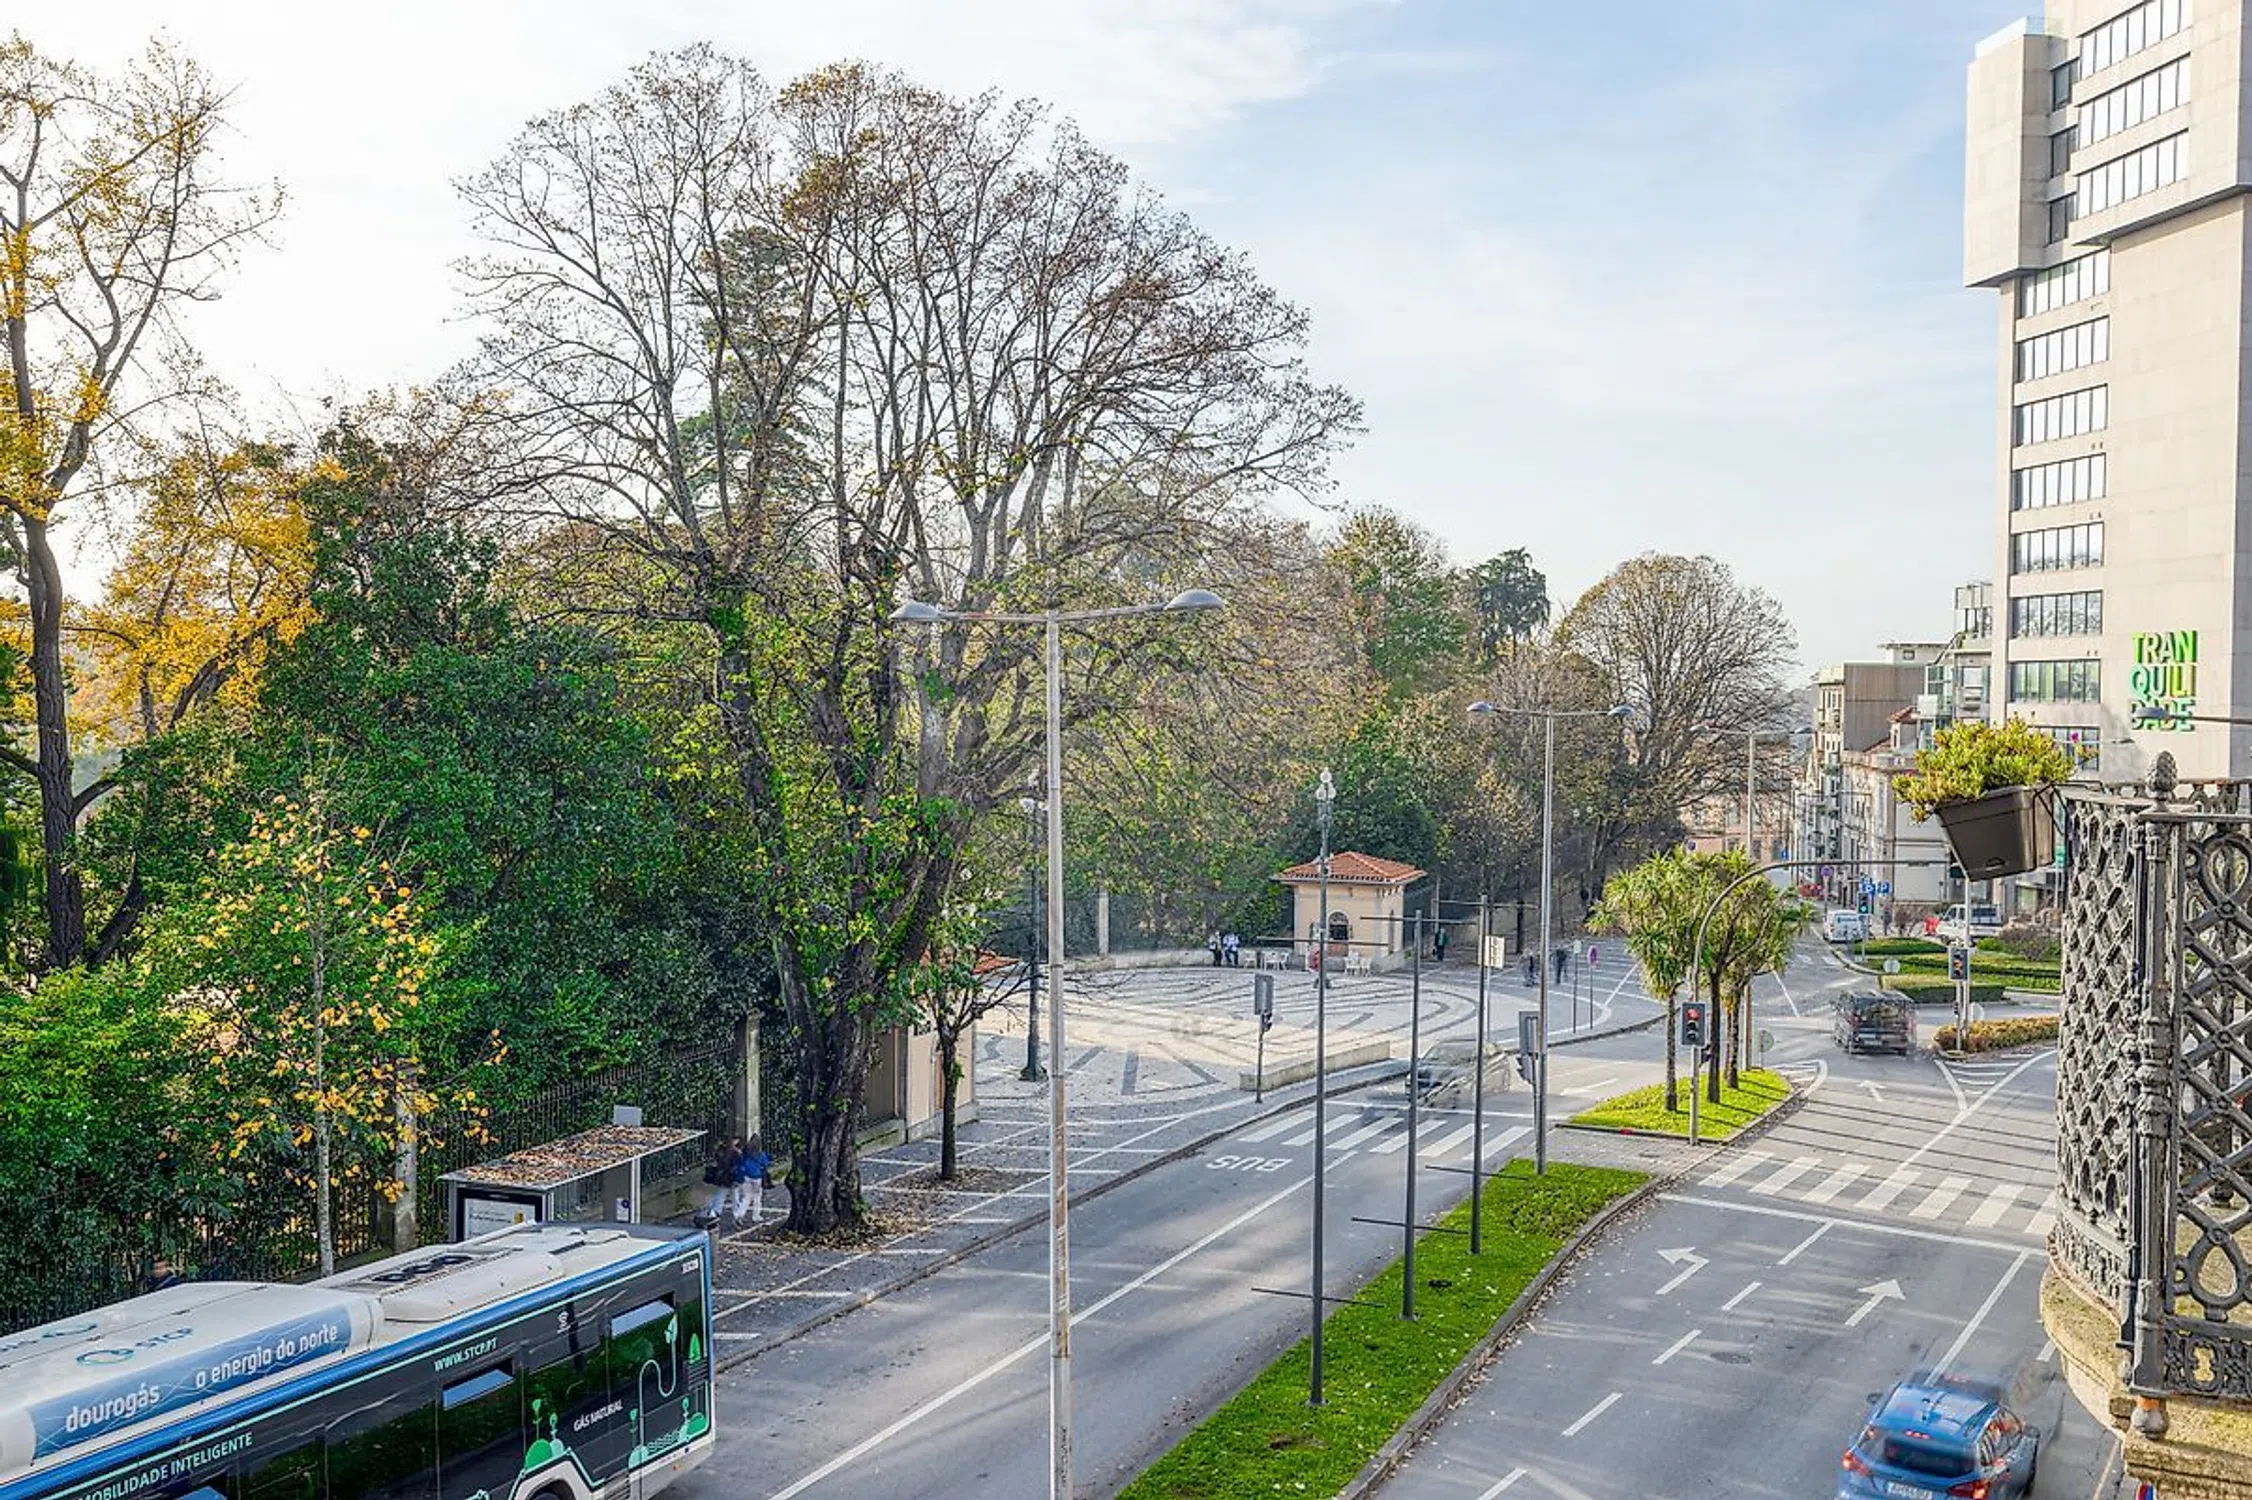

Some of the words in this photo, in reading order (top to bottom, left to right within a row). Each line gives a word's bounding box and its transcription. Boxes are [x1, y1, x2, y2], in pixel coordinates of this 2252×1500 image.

[2130, 629, 2198, 663] TRAN
[1206, 1155, 1293, 1171] BUS
[196, 1370, 206, 1389] a
[212, 1348, 271, 1382] energia
[277, 1339, 296, 1366] do
[300, 1322, 339, 1352] norte
[65, 1382, 161, 1433] dourogás
[78, 1463, 169, 1500] OBILIDADE
[170, 1432, 253, 1474] INTELIGENTE
